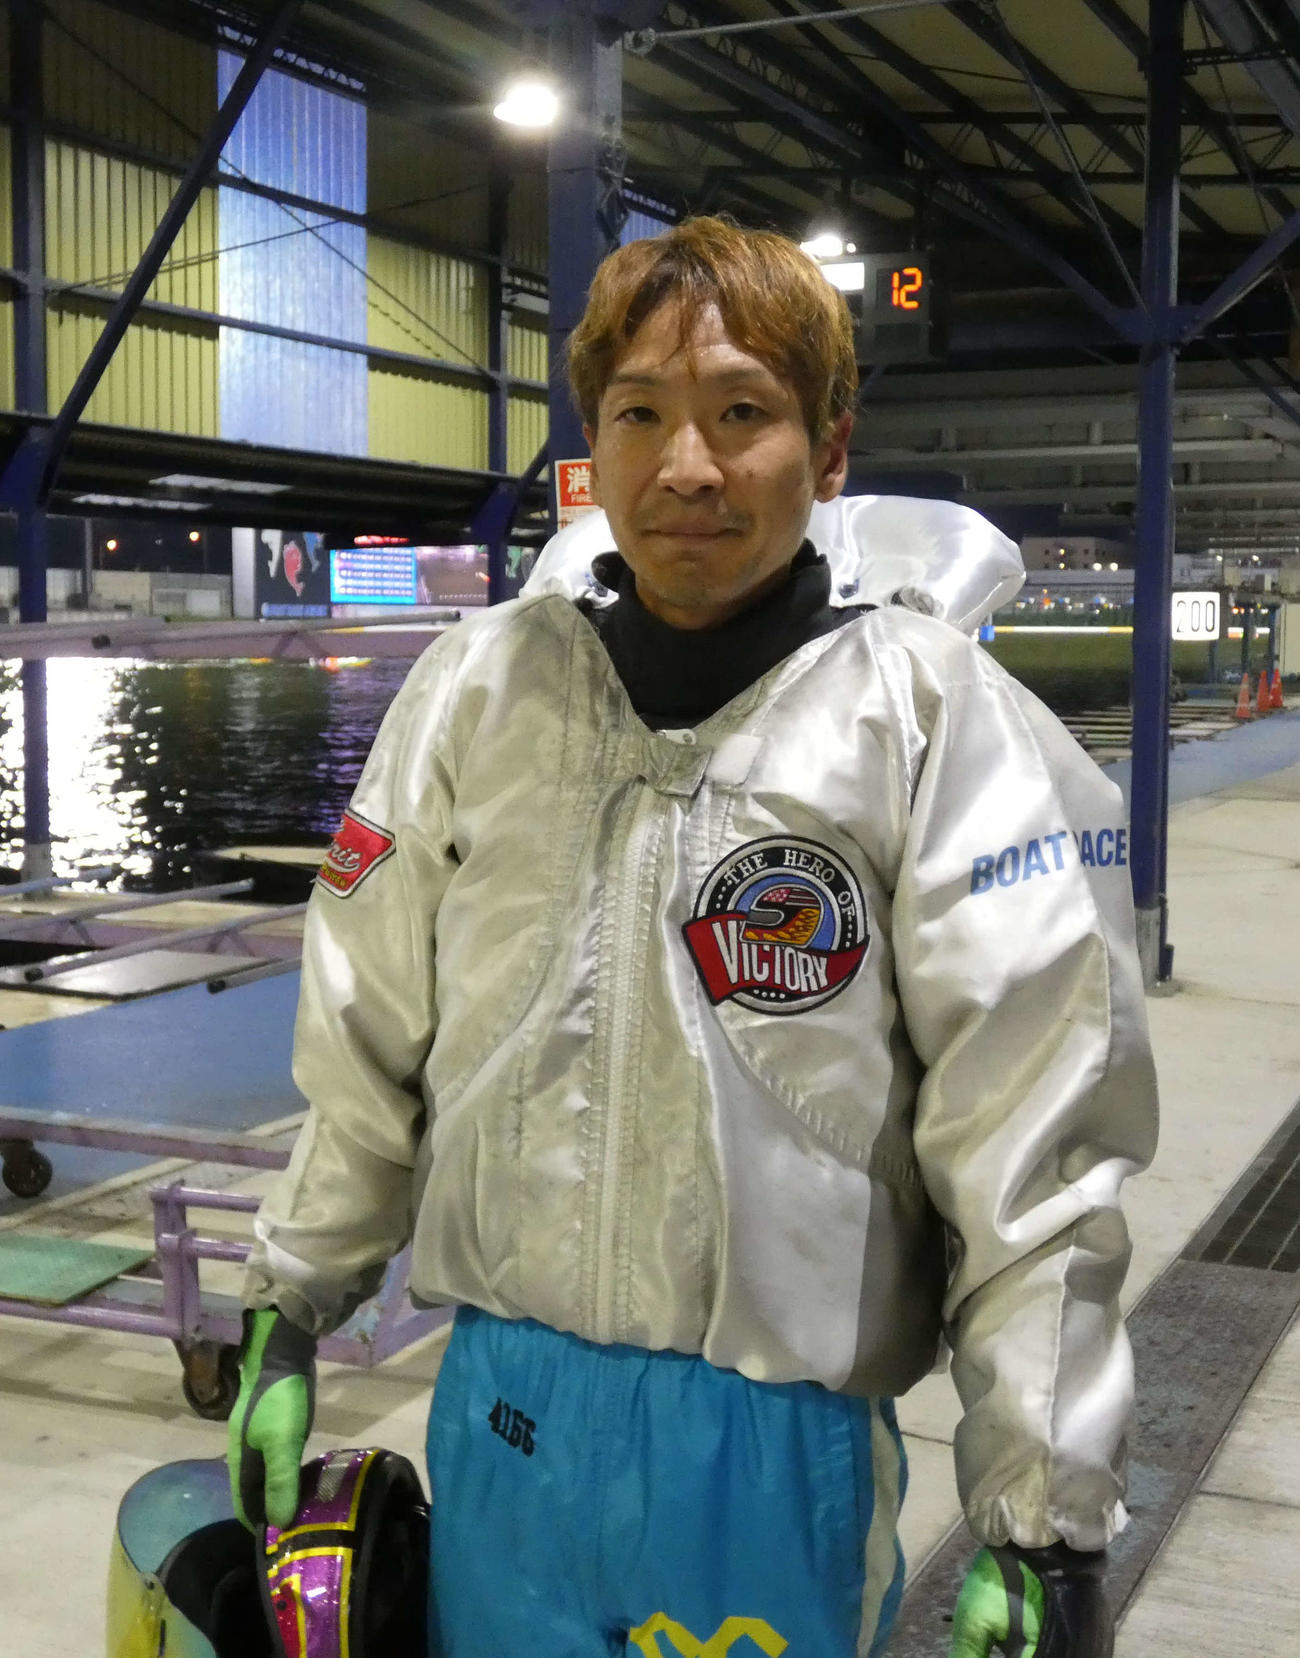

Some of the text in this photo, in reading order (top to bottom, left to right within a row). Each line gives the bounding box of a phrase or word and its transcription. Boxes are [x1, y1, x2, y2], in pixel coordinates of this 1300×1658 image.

[892, 267, 923, 310] 12
[570, 494, 592, 504] FIRE
[1176, 600, 1216, 633] 200
[723, 848, 857, 918] THE HERO OF
[970, 828, 1127, 896] BOAT ACE
[711, 919, 829, 993] VICTORY
